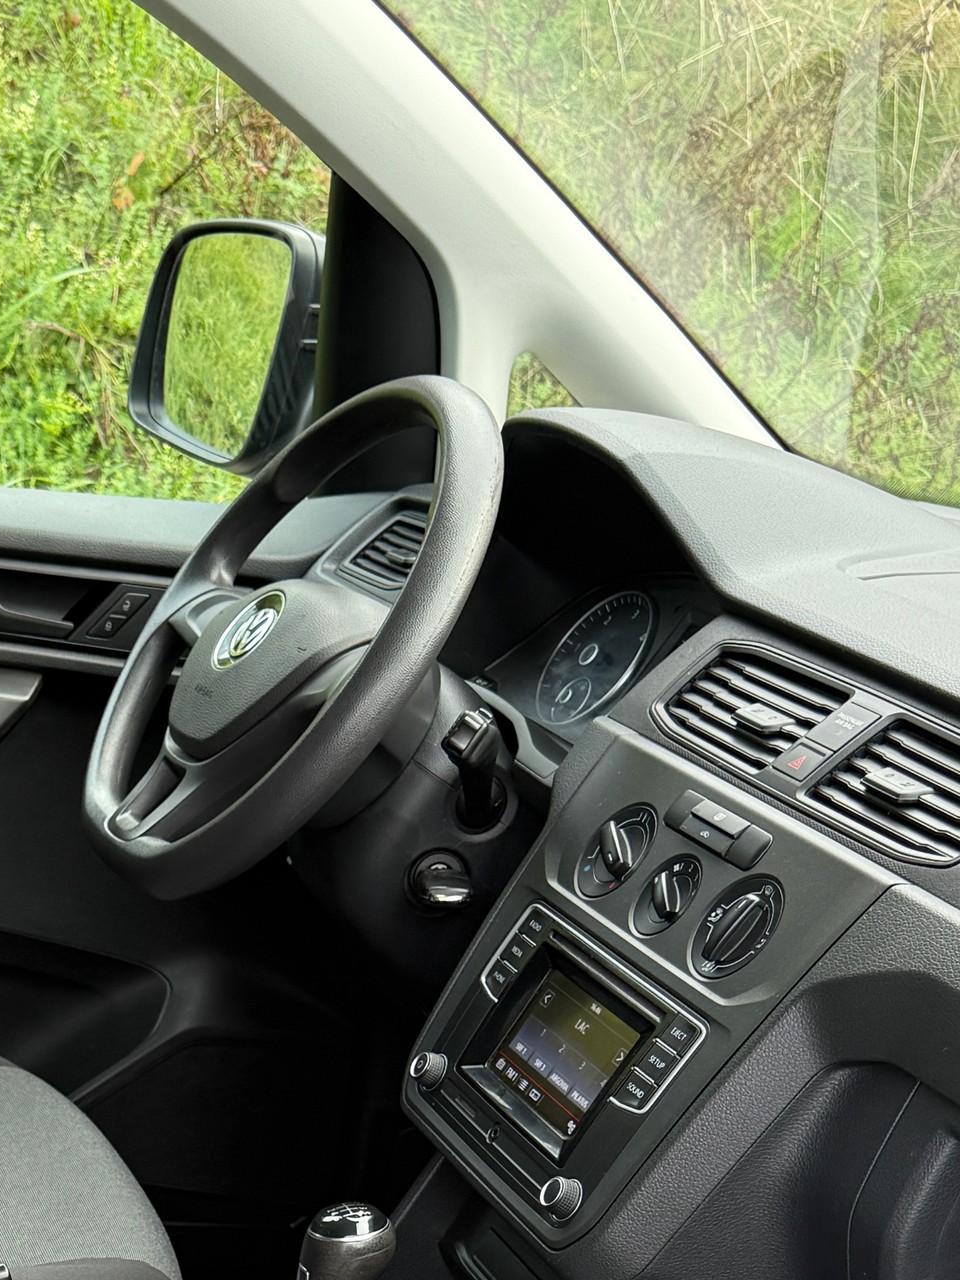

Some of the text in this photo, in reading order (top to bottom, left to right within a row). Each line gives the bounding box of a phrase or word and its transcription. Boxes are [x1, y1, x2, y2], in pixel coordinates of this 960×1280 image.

[574, 1018, 590, 1035] LAC
[670, 1026, 688, 1041] EJECT
[558, 1044, 566, 1053] 2
[578, 1060, 586, 1070] 3
[648, 1054, 666, 1069] SETUP
[626, 1082, 645, 1099] SOUND
